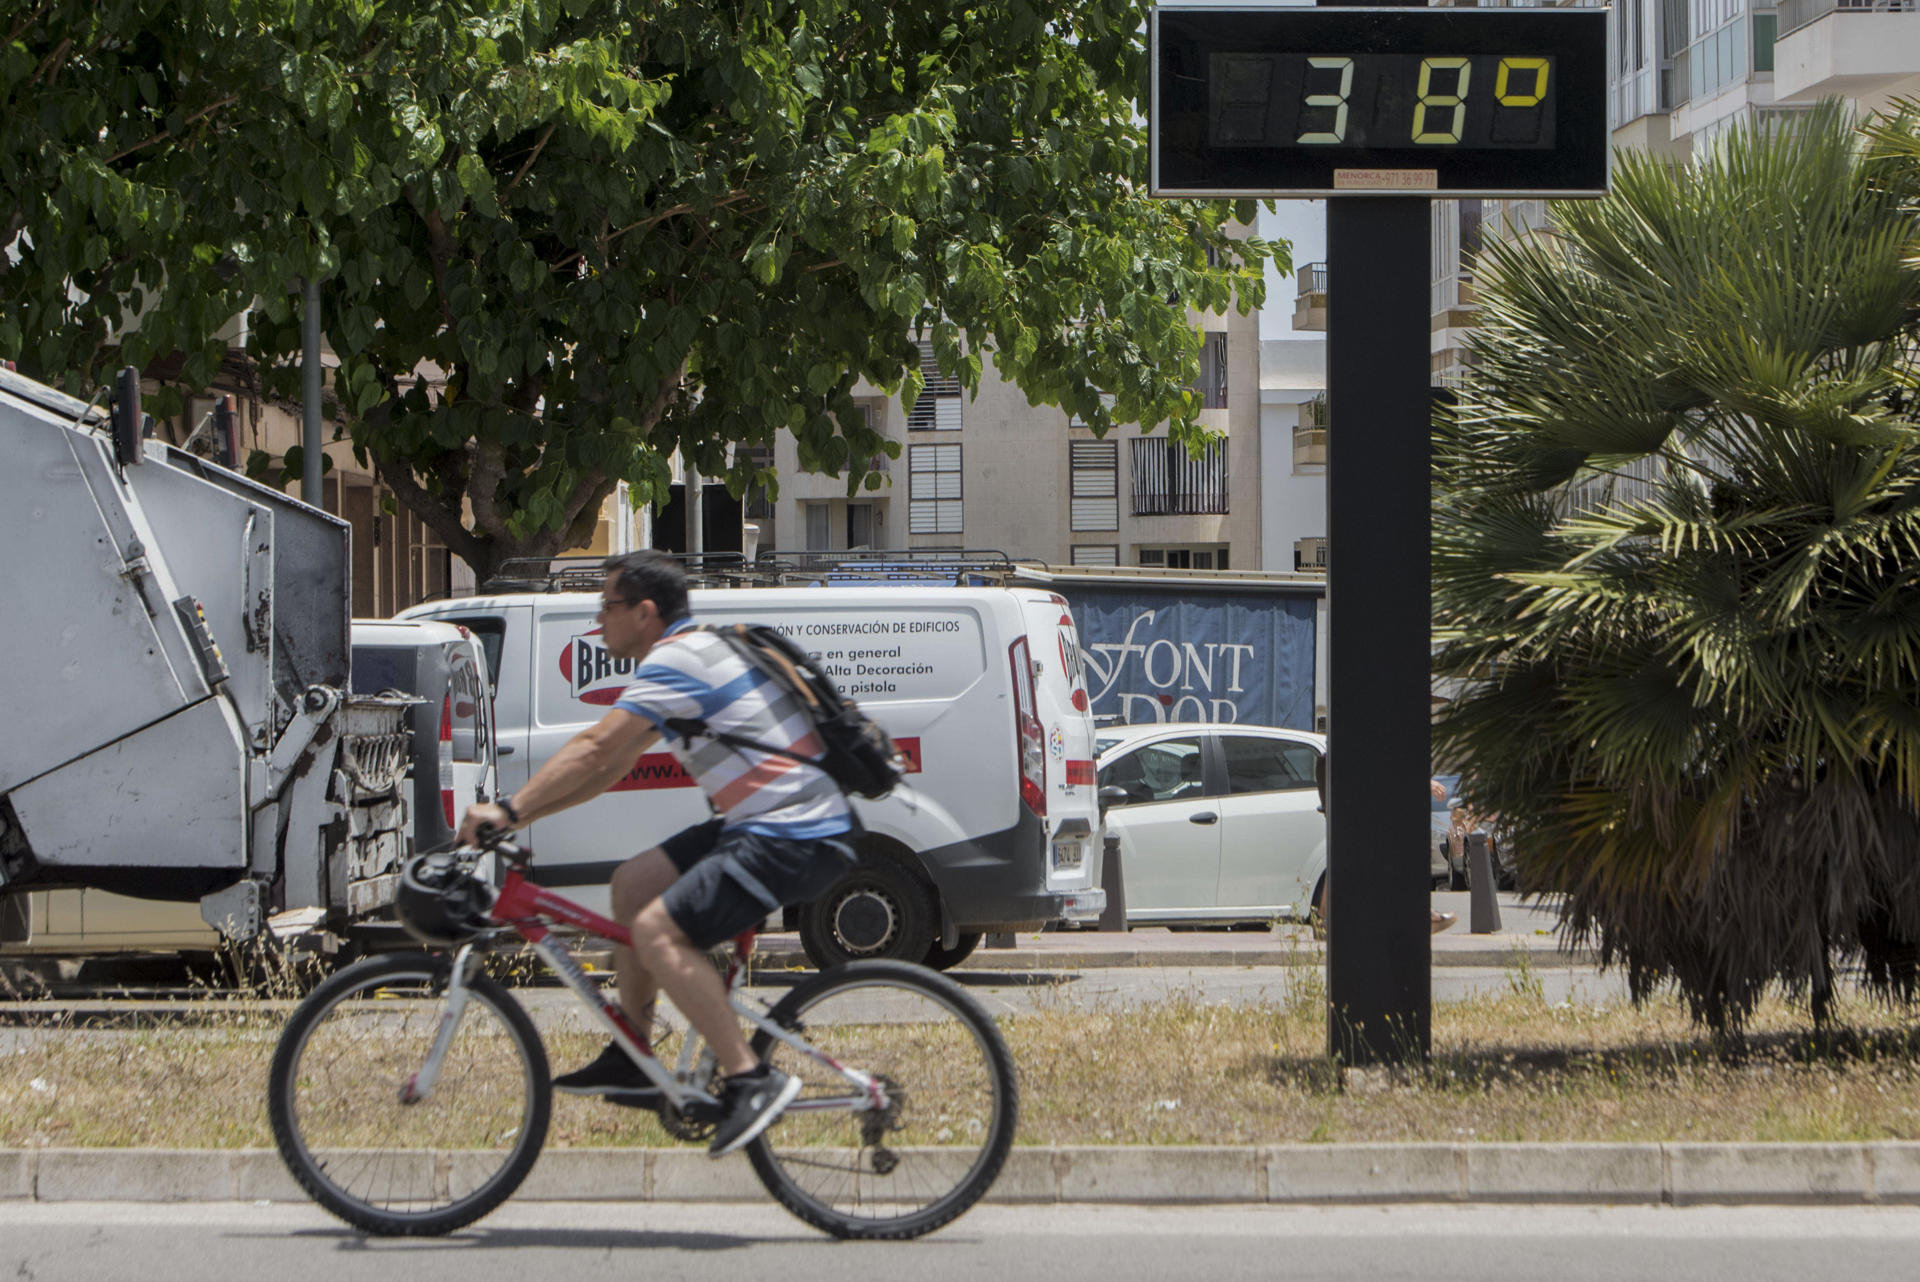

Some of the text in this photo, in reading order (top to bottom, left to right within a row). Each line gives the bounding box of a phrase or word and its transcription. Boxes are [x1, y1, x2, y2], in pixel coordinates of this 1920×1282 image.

[796, 625, 803, 636] Y
[806, 620, 889, 635] CONSERVACIÓN
[893, 622, 906, 633] DE
[910, 620, 960, 633] EDIFICIOS
[827, 651, 844, 659] en
[848, 646, 901, 661] general
[578, 639, 638, 690] BRU
[825, 662, 933, 676] Alta Decoración
[837, 681, 896, 696] a pistola
